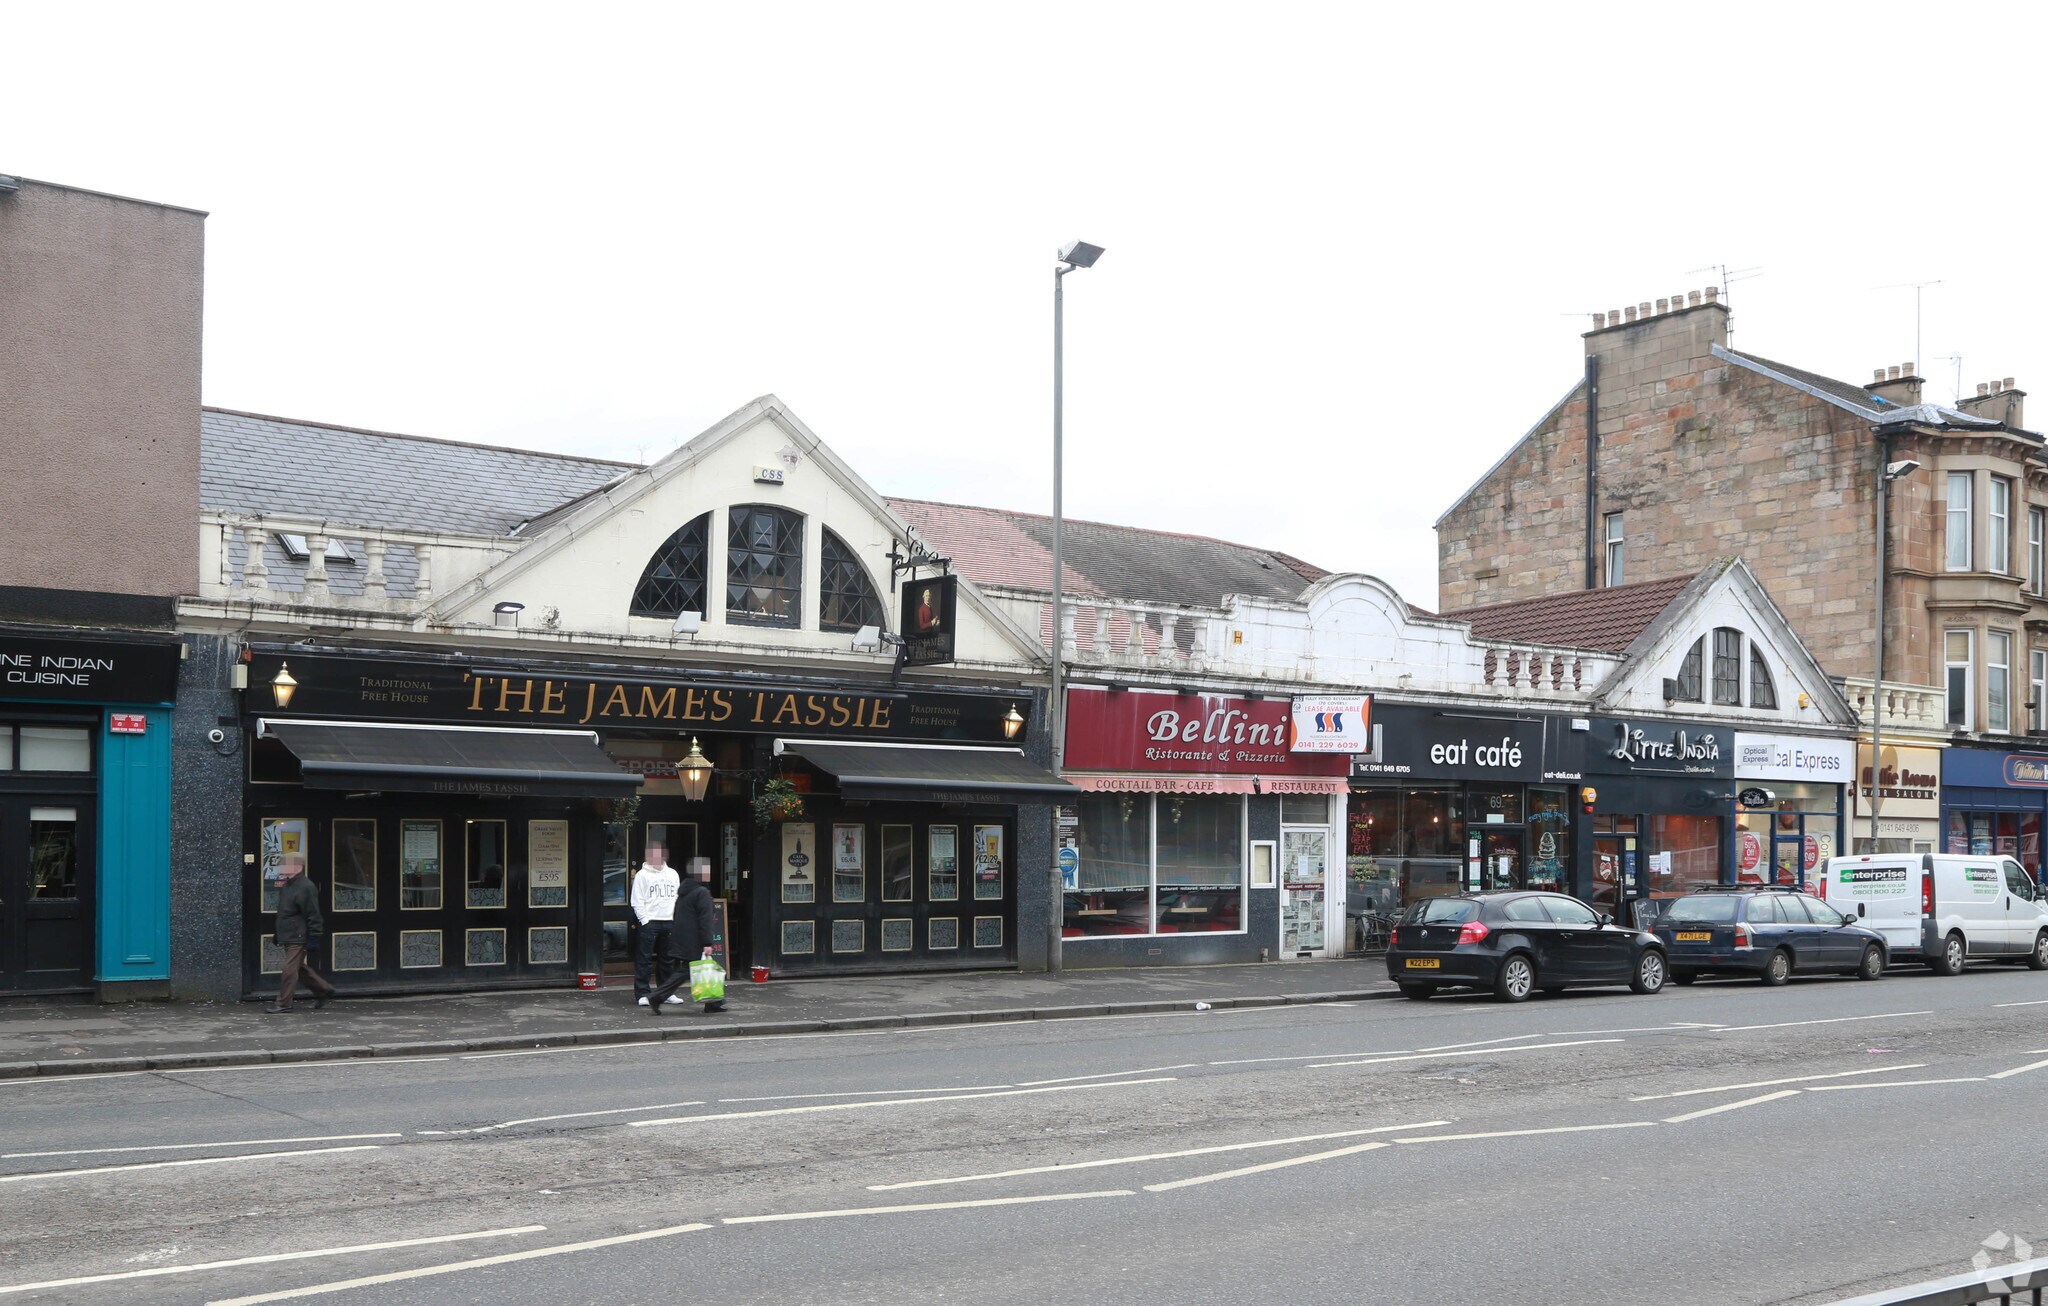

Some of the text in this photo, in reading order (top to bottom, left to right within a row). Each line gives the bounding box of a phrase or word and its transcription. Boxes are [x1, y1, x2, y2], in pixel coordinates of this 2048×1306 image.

[41, 656, 113, 671] INDIAN
[7, 671, 90, 686] CUISINE
[463, 673, 893, 729] THE JAMES TASSIE
[1326, 705, 1360, 713] AVAILABLE
[1146, 708, 1288, 746] Bellini
[1337, 741, 1359, 749] 6029
[1145, 747, 1213, 761] Ristorante
[1236, 750, 1286, 763] Pizzeria
[1430, 737, 1522, 768] eat café
[1744, 747, 1768, 755] Optical
[1795, 750, 1840, 773] Express
[1369, 764, 1382, 772] 0141
[1396, 765, 1411, 773] 6705
[1544, 772, 1581, 780] eat-deli.co.uk
[433, 782, 529, 794] THE JAMES TASSIE
[1096, 779, 1151, 789] COCKTAIL
[1155, 781, 1177, 790] BAR
[1187, 781, 1214, 790] CAFE
[1271, 782, 1338, 791] RESTAURANT
[1896, 790, 1929, 798] SALON
[1490, 796, 1502, 808] 69
[1880, 823, 1893, 832] 0141
[1744, 841, 1756, 849] 50%
[1841, 869, 1906, 880] enterprise
[1966, 870, 1998, 880] enterprise
[649, 884, 675, 898] POLICE
[1853, 888, 1873, 896] 0800
